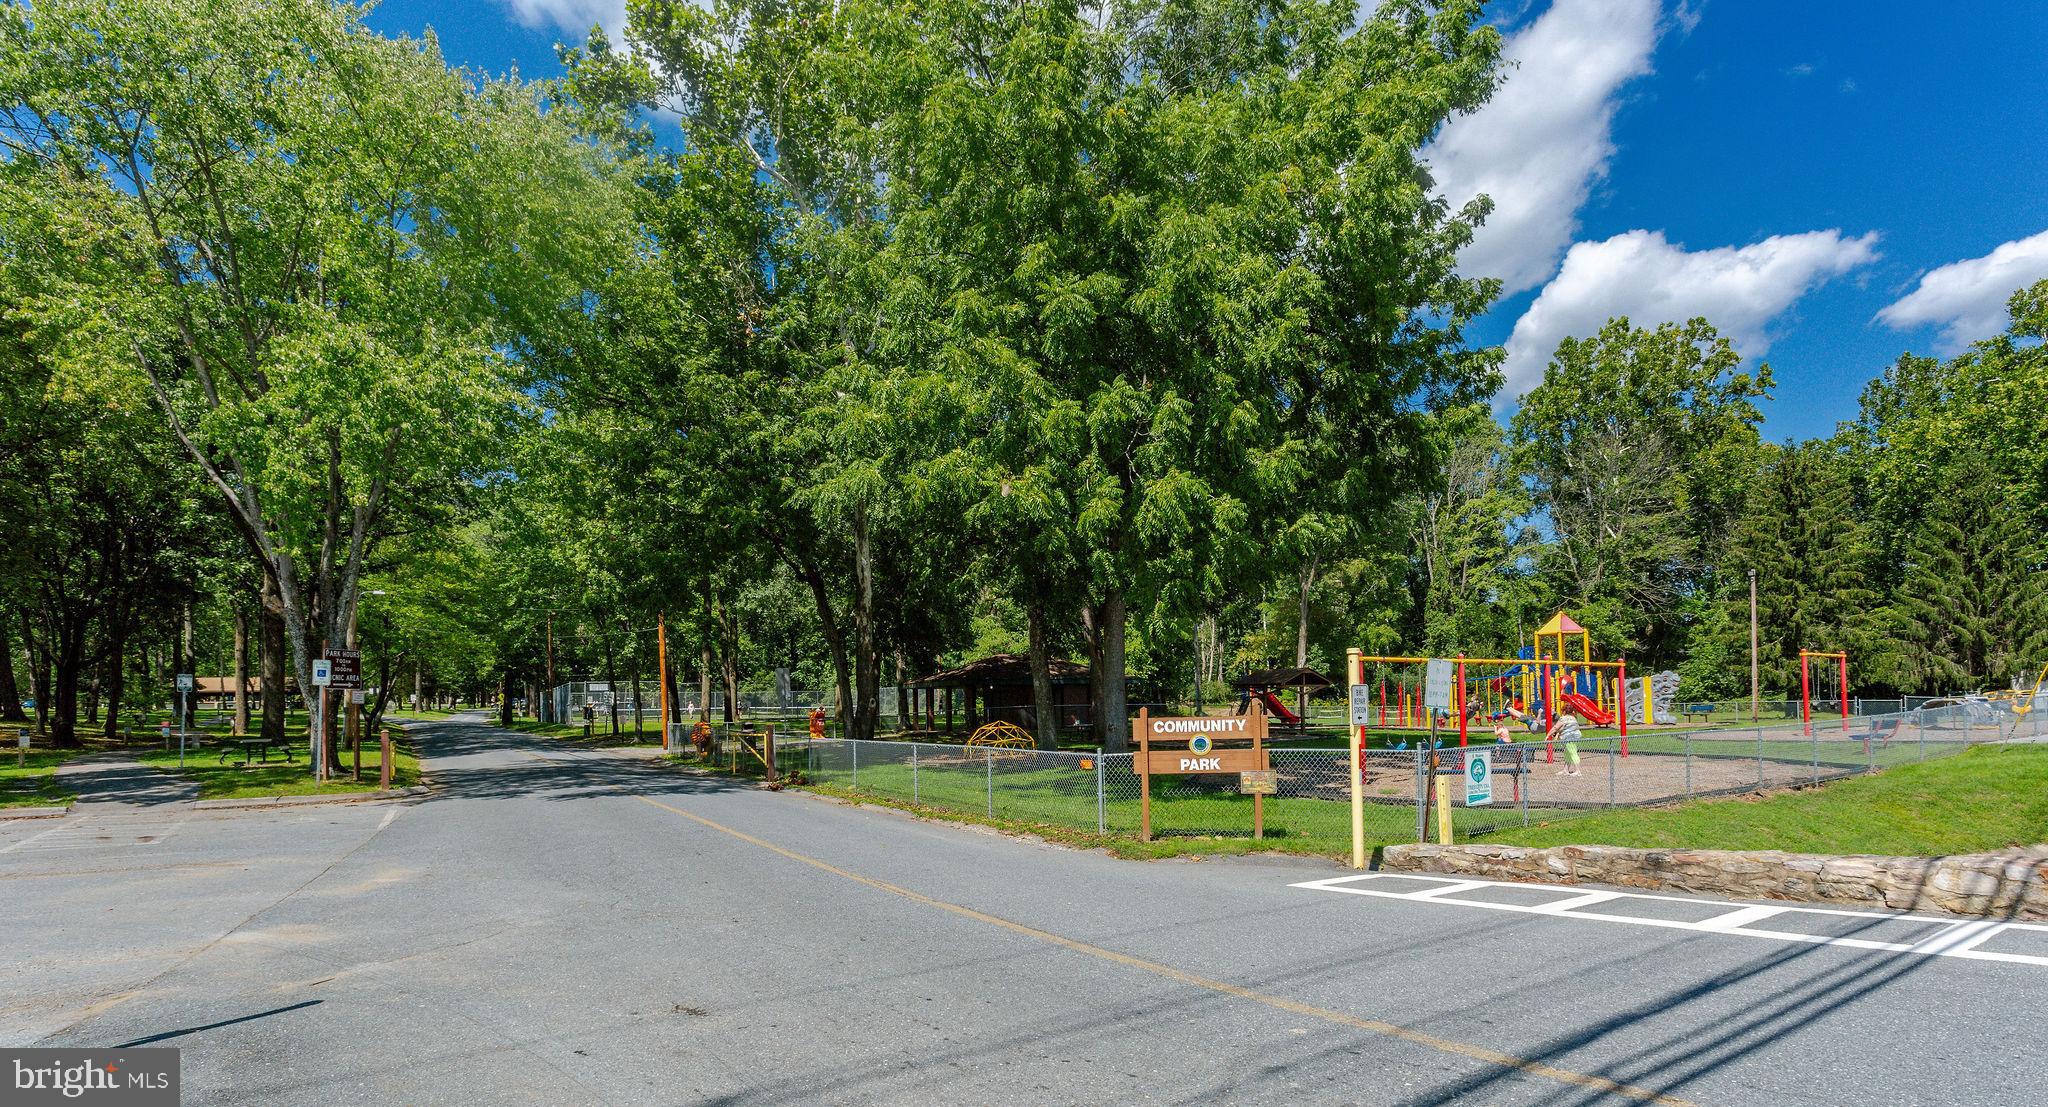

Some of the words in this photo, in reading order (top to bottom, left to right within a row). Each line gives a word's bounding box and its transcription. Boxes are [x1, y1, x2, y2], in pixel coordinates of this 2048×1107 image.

[326, 649, 341, 657] PARK
[342, 651, 360, 659] HOURS
[1153, 719, 1247, 733] COMMUNITY
[1180, 757, 1221, 771] PARK
